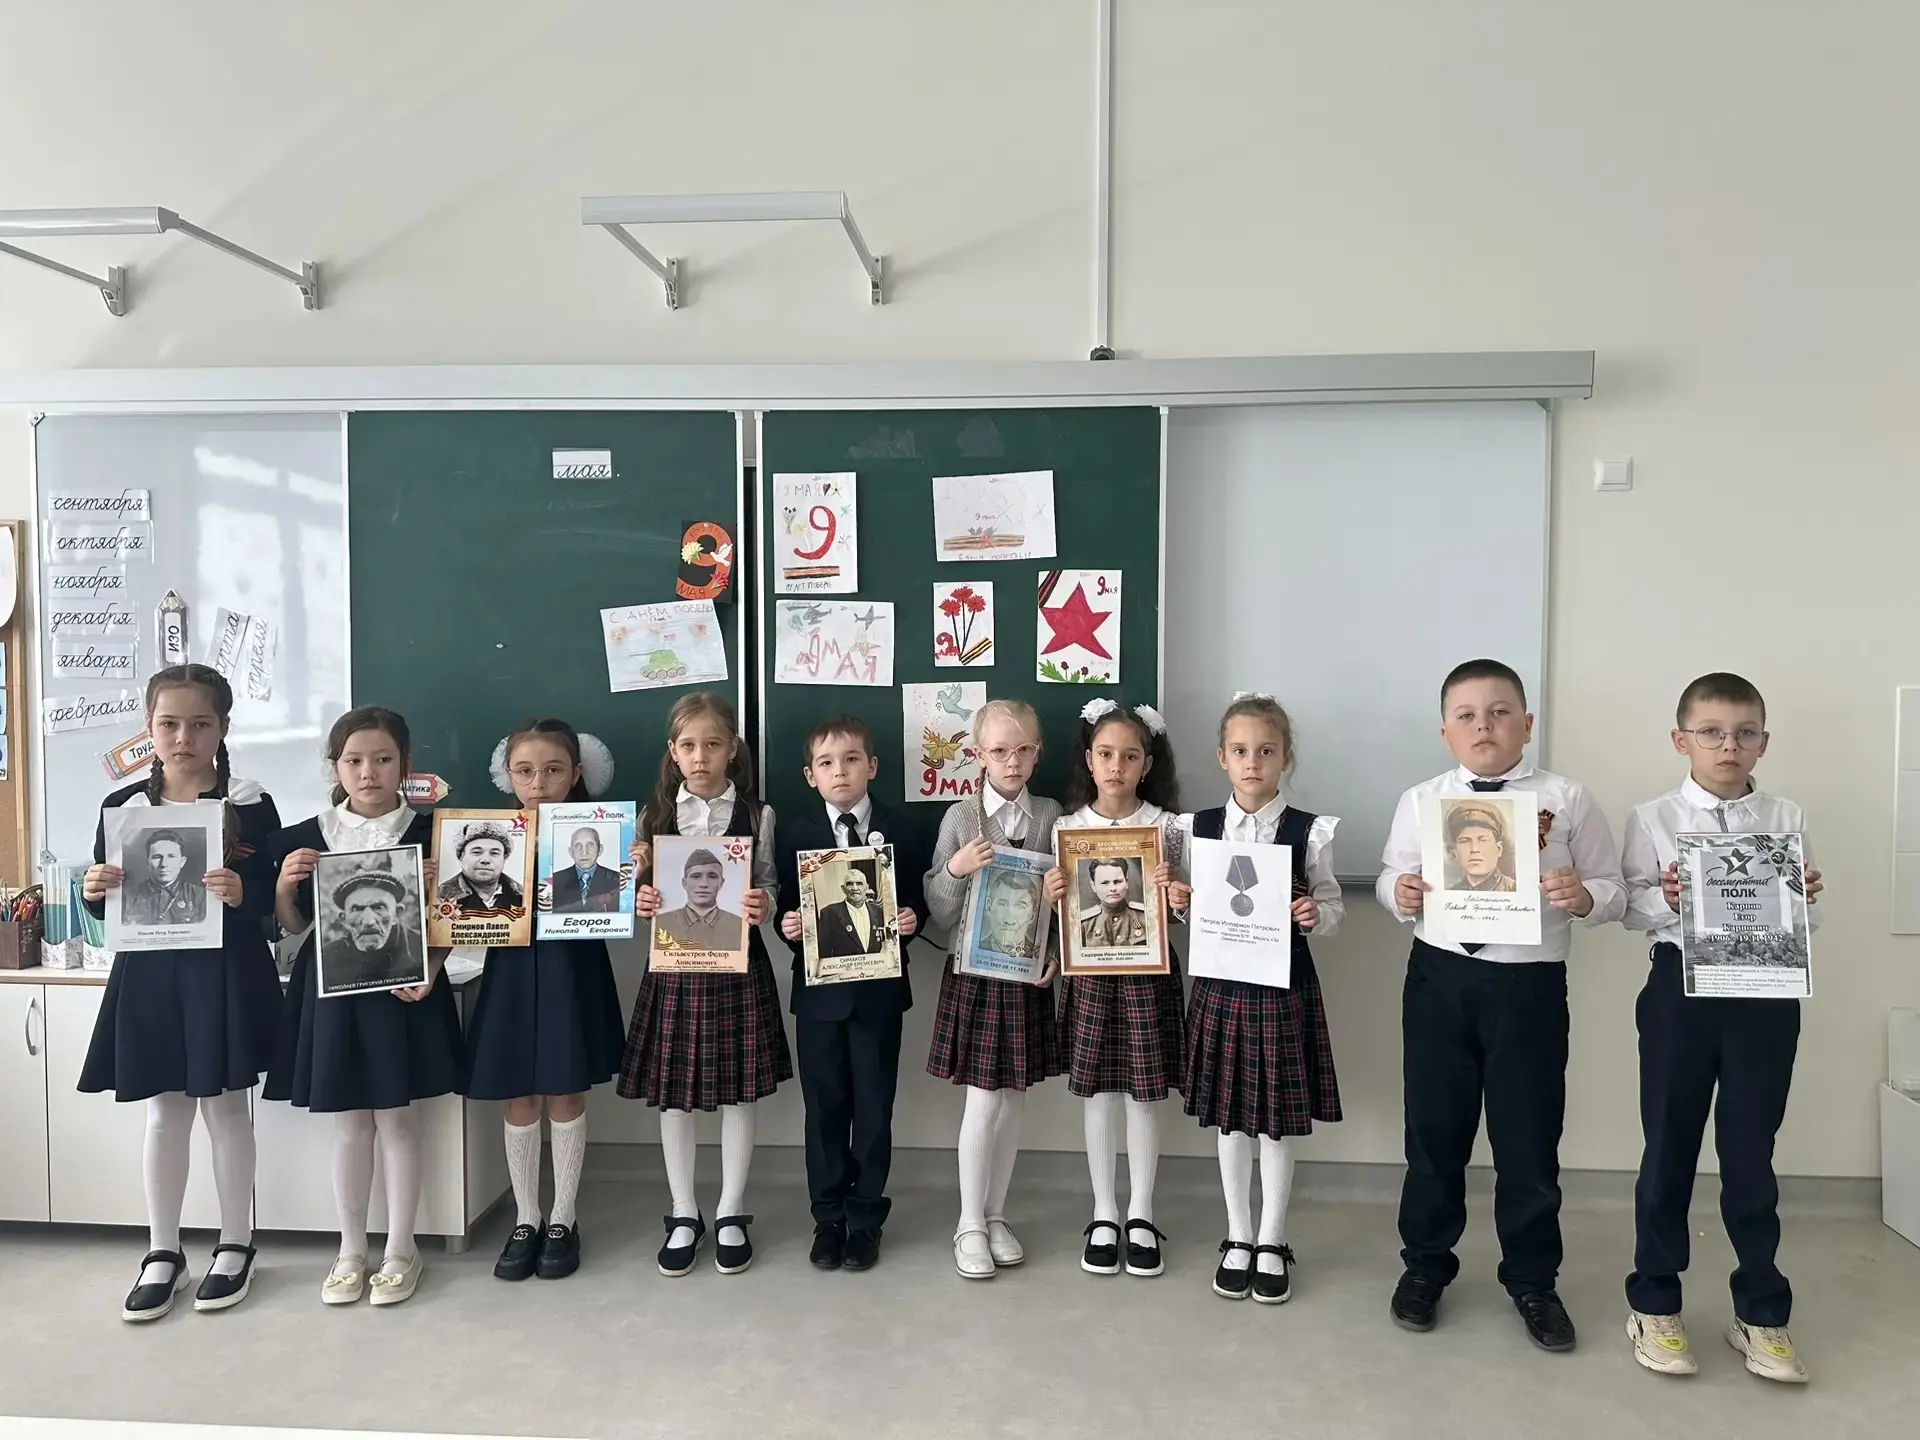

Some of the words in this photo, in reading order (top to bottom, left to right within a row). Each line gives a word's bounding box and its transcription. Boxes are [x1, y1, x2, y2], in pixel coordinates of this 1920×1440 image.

[556, 463, 611, 478] мая
[53, 488, 146, 519] сентября
[56, 526, 144, 558] октября
[793, 505, 836, 560] 9
[53, 566, 122, 597] ноября
[677, 583, 706, 598] МАЯ
[1097, 575, 1106, 596] 9
[51, 602, 133, 634] декабря
[168, 625, 181, 652] ИЗО
[215, 611, 240, 675] арта
[56, 646, 130, 677] января
[49, 696, 139, 730] февраля
[129, 740, 154, 758] Труд
[920, 768, 937, 796] 9
[1721, 888, 1757, 898] ПОЛК
[1726, 902, 1762, 912] Карпов
[563, 918, 611, 927] Егоров
